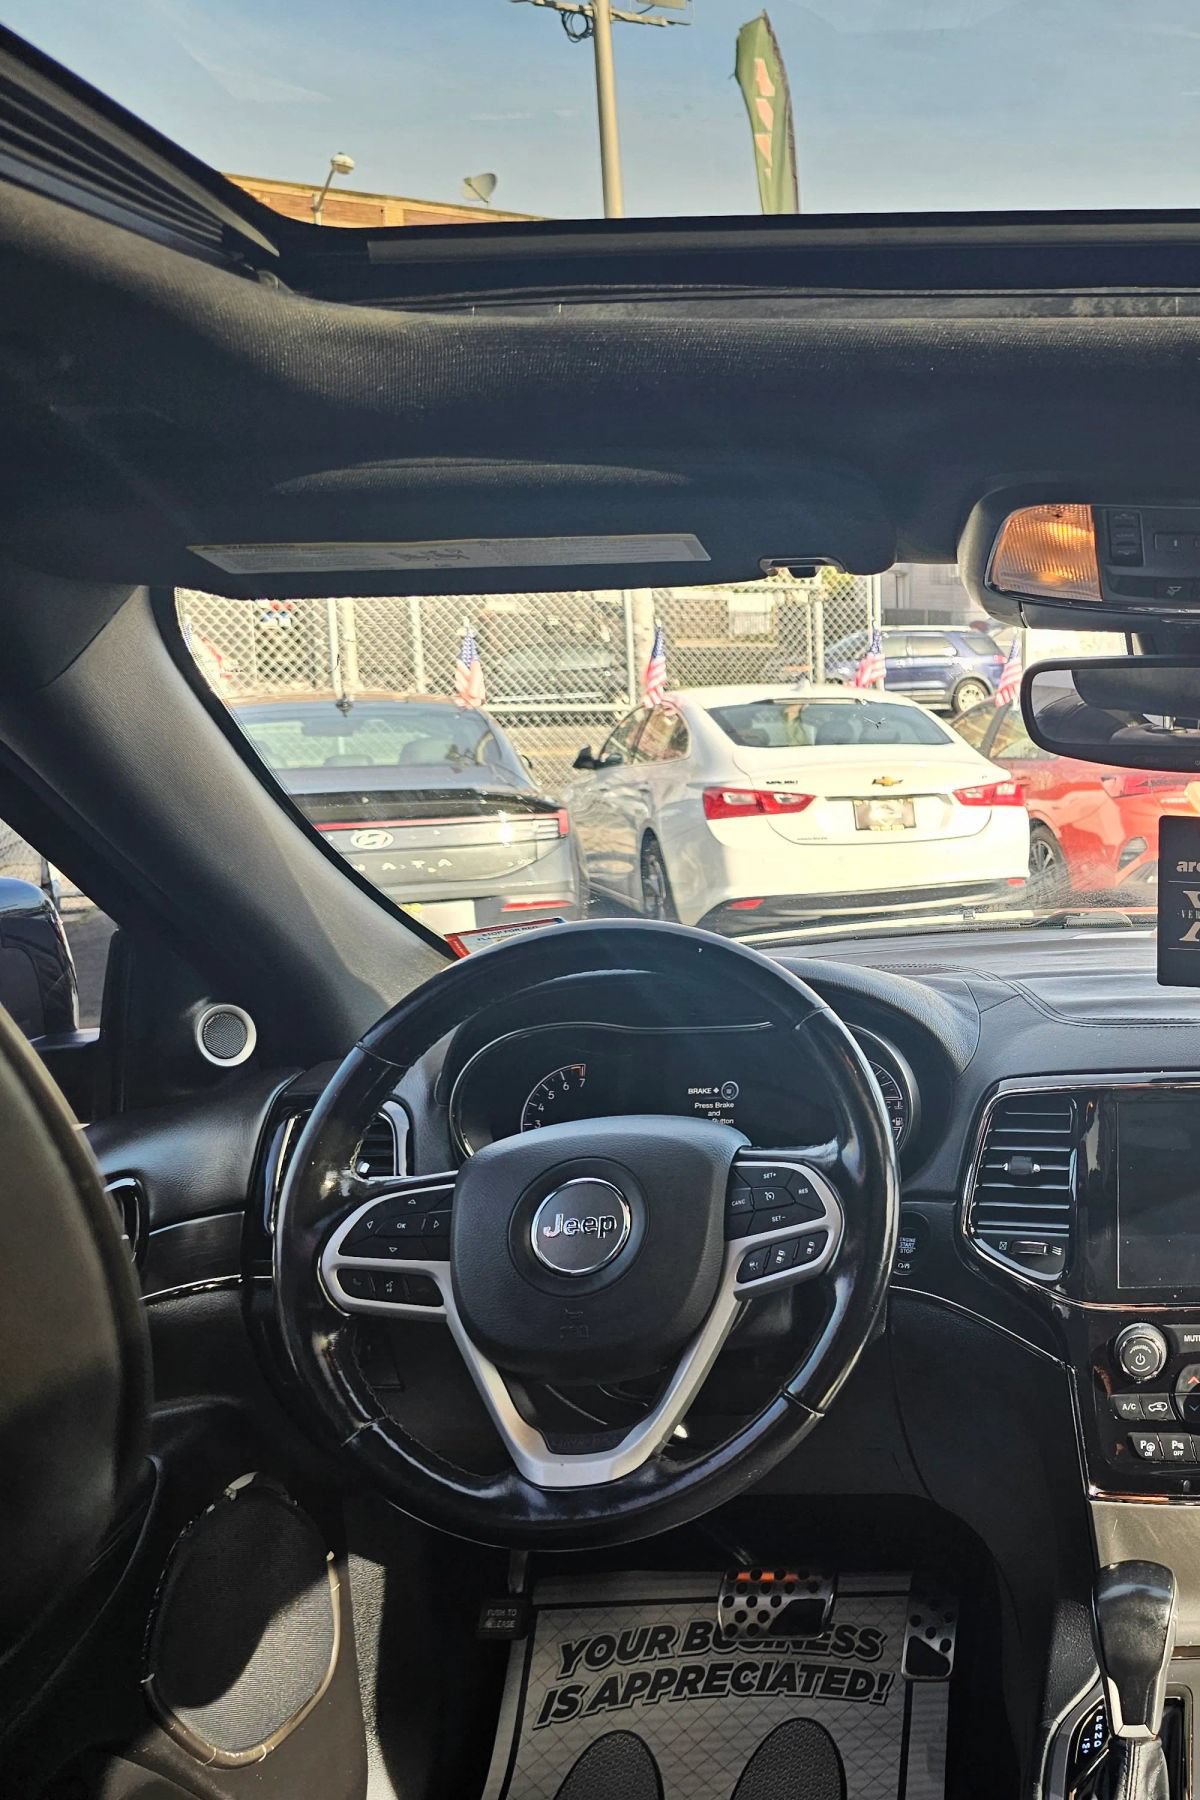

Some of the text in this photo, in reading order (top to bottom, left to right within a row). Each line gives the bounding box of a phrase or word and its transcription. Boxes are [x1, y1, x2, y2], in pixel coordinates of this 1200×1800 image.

[563, 1082, 569, 1091] 6
[579, 1079, 586, 1087] 7
[548, 1091, 555, 1099] 5
[688, 1087, 712, 1095] BRAKE
[538, 1104, 544, 1112] 4
[715, 1101, 735, 1109] Brake
[534, 1120, 541, 1129] 3
[731, 1199, 746, 1207] CANC
[543, 1213, 617, 1239] Jeep
[1122, 1403, 1137, 1411] A/C
[558, 1625, 679, 1679] YOUR
[535, 1662, 894, 1726] IS APPRECIATED!
